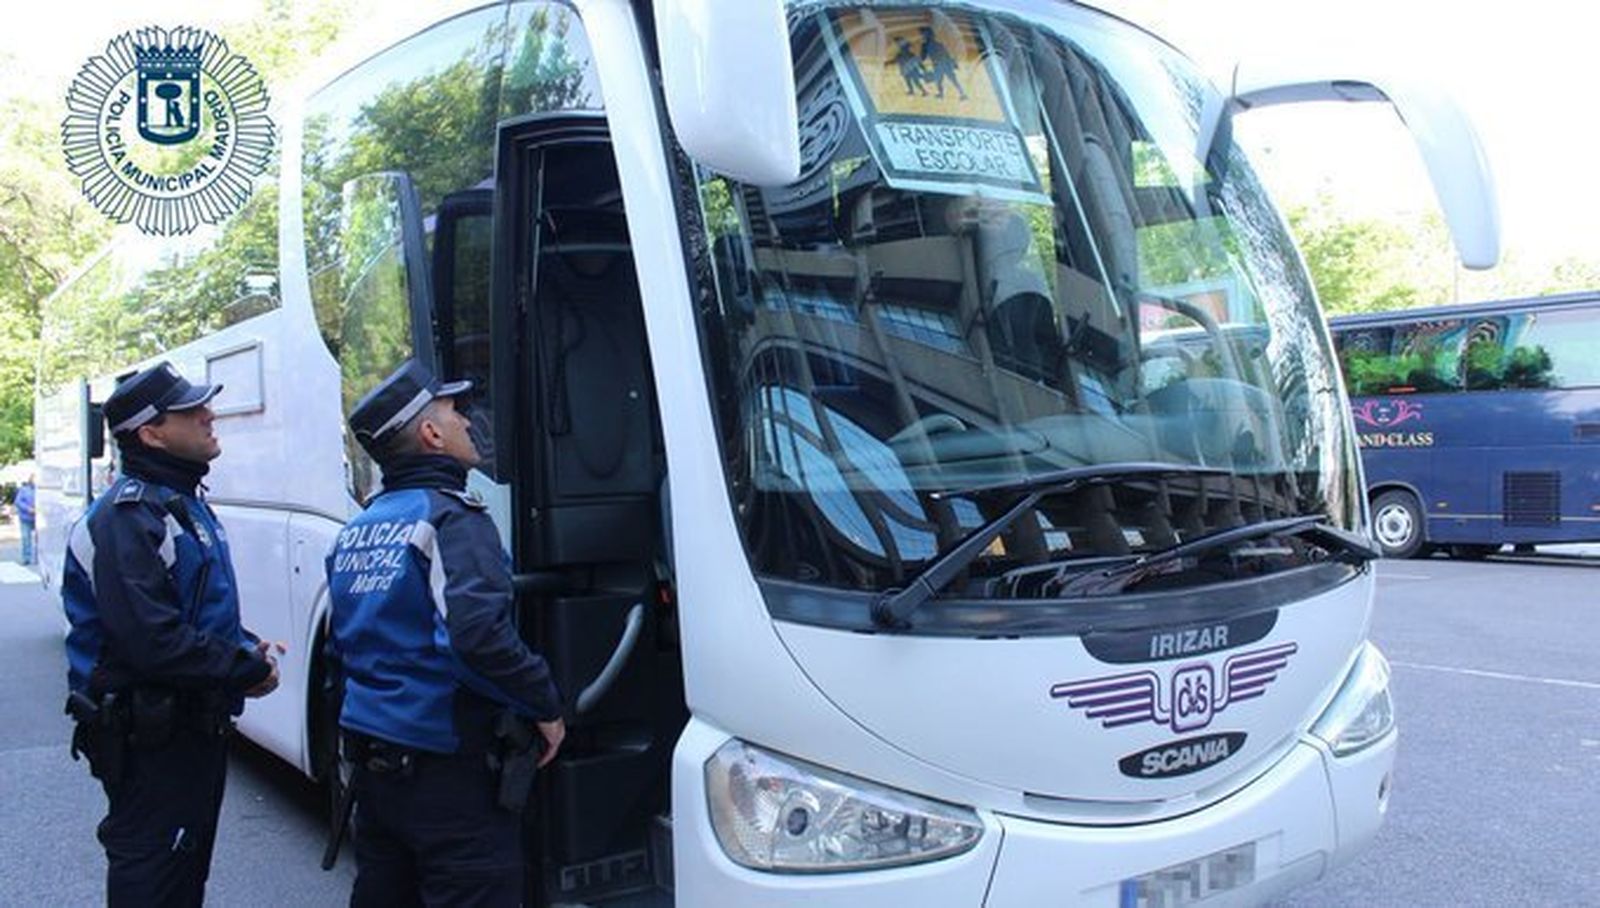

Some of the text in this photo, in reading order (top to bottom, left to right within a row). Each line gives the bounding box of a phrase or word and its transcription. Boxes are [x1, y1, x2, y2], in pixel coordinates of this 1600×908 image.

[885, 124, 1019, 156] TRANSPORTE
[916, 149, 1012, 176] ESCOLAR
[1151, 626, 1228, 657] IRIZAR
[1142, 737, 1230, 774] SCANIA
